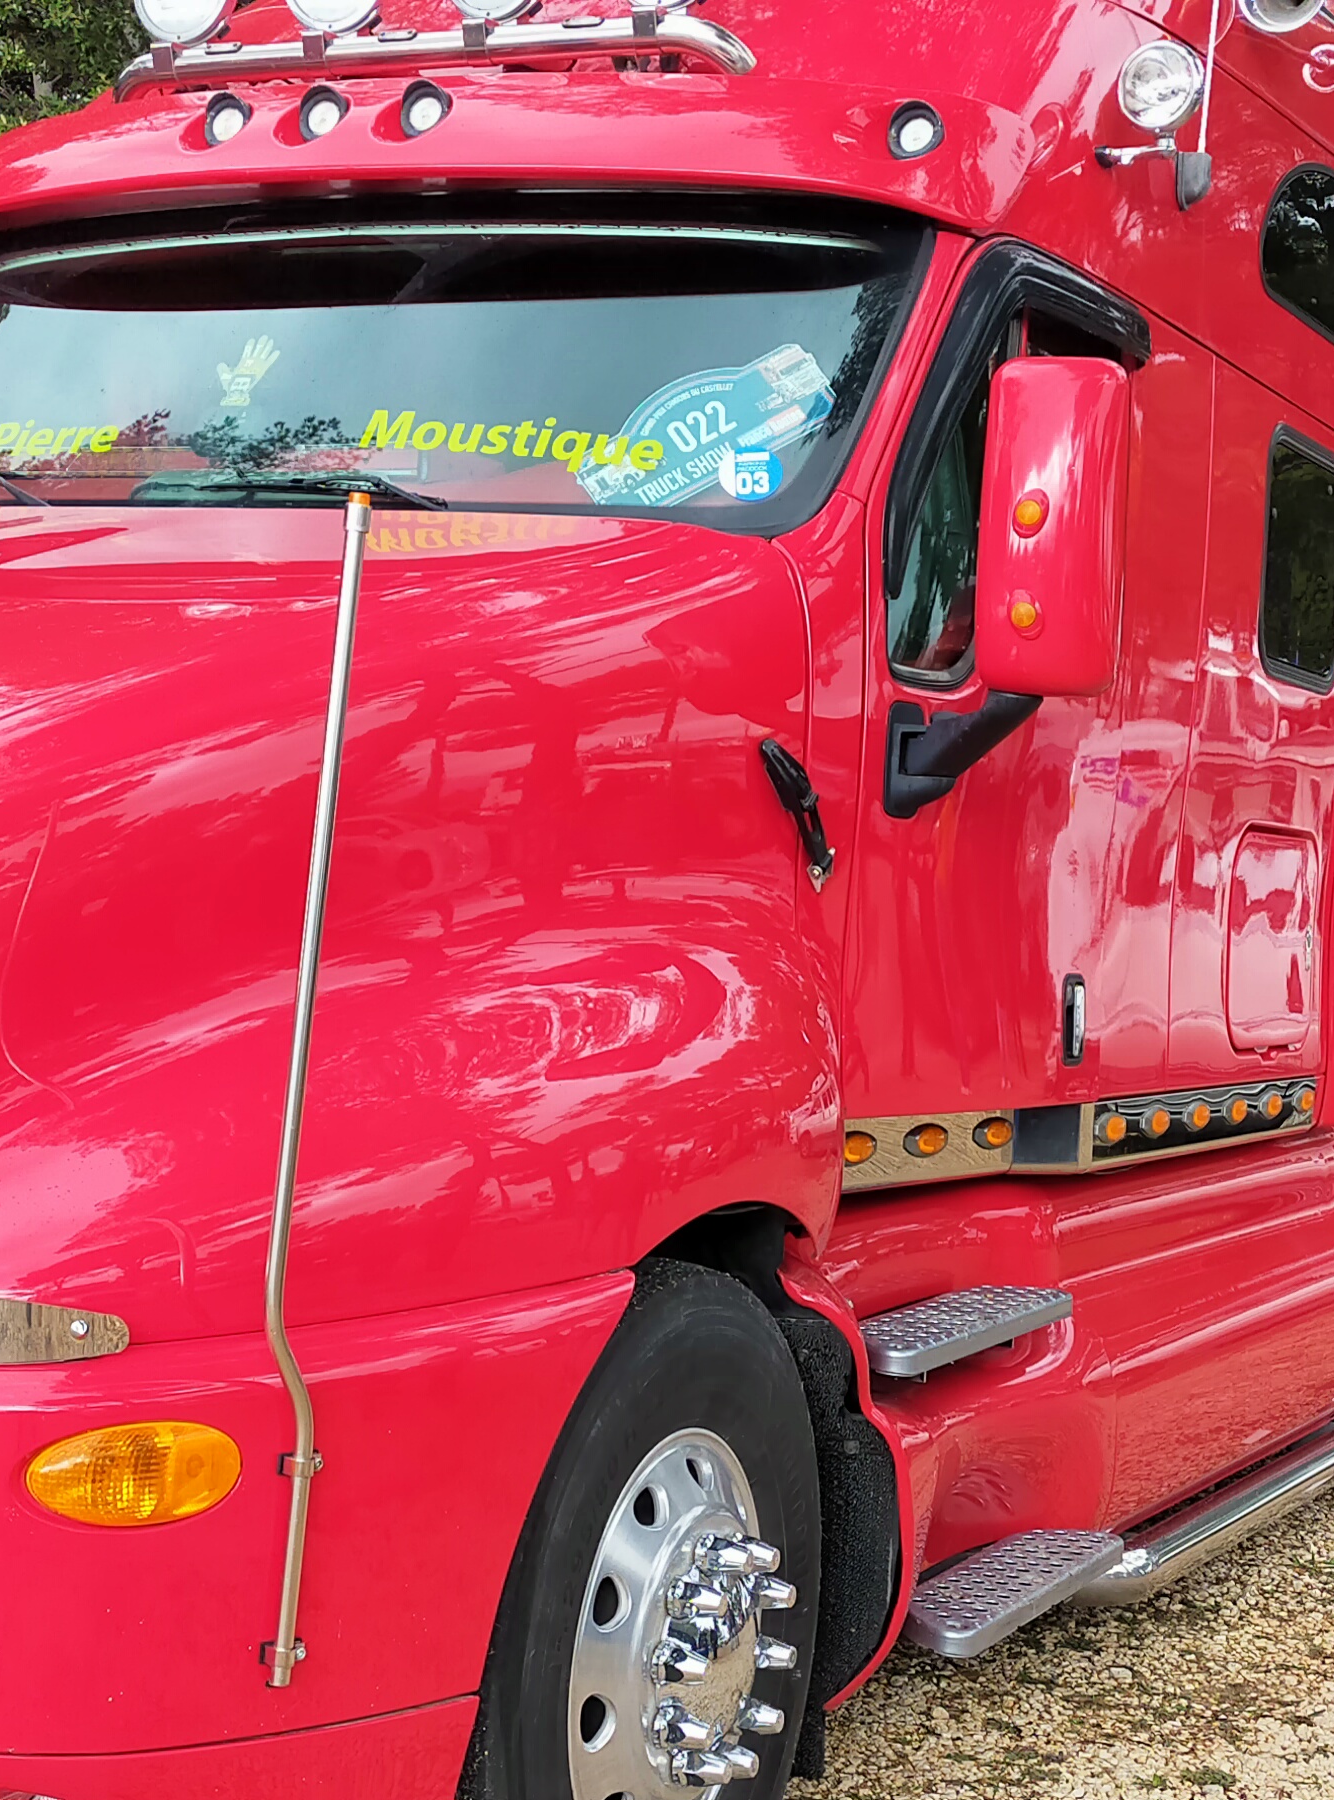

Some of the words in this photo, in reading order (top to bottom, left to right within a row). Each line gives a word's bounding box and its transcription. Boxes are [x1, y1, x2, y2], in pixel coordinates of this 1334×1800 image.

[359, 409, 664, 473] Moustique
[666, 400, 738, 453] 022
[633, 469, 690, 506] TRUCK
[686, 441, 734, 480] SHOW
[737, 471, 770, 494] 03
